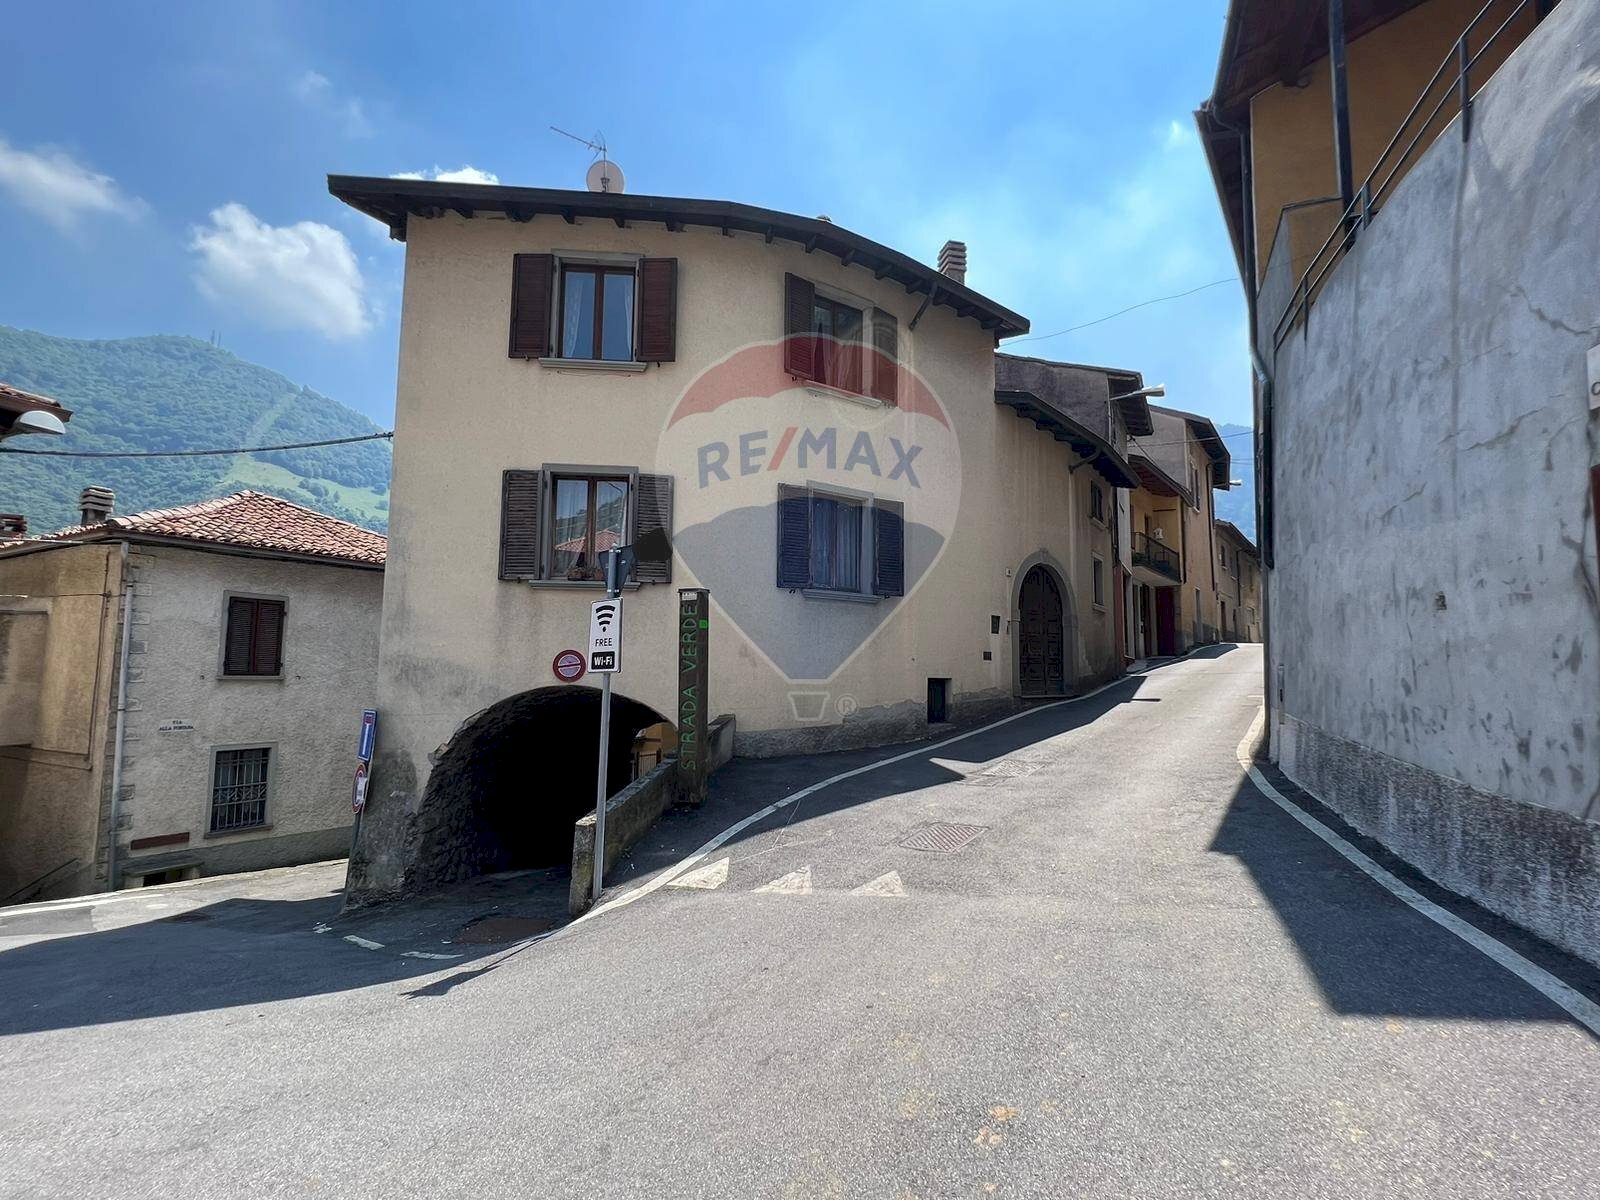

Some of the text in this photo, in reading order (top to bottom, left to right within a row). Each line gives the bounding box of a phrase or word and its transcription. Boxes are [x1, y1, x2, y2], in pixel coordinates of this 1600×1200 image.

[594, 637, 613, 647] FREE
[682, 603, 698, 673] VERDE
[681, 685, 697, 770] STRADA
